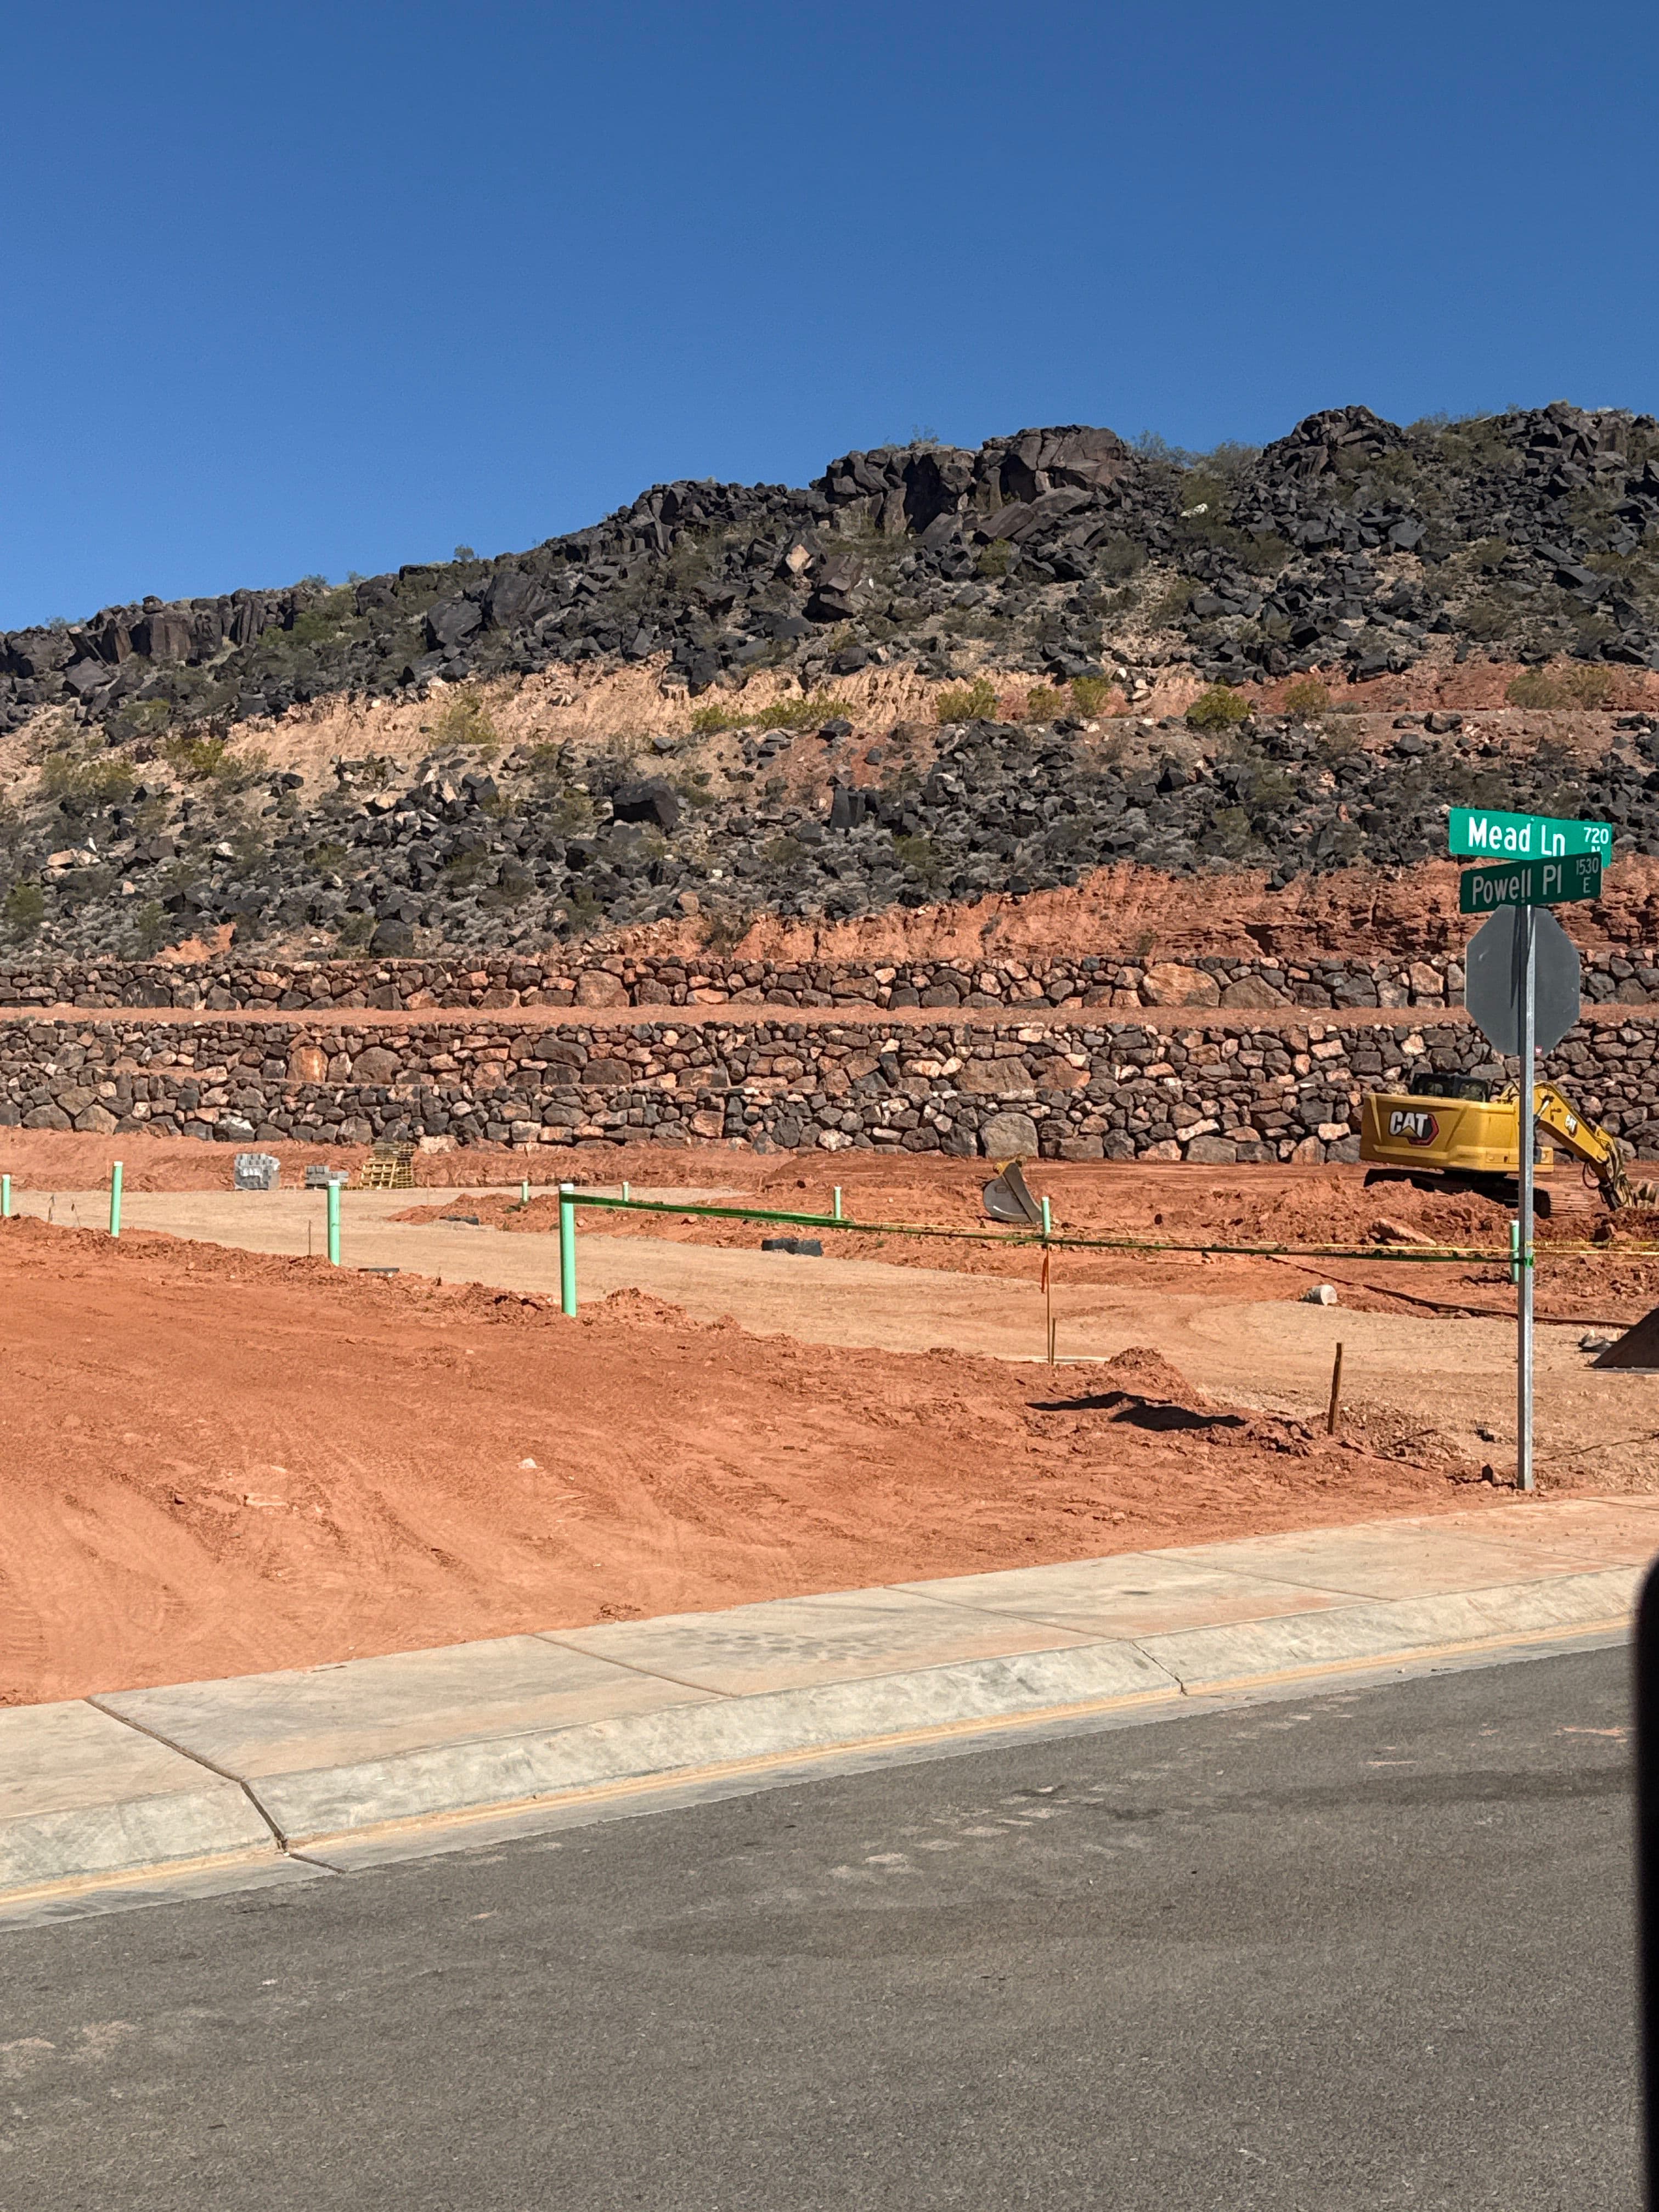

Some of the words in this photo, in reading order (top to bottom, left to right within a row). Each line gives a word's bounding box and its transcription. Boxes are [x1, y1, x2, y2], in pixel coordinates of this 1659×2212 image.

[1468, 816, 1531, 852] Mead
[1541, 824, 1565, 856] Ln
[1583, 827, 1609, 844] 720
[1576, 857, 1599, 876] 1530
[1472, 868, 1532, 905] Powell
[1543, 864, 1562, 895] Pl
[1583, 877, 1591, 894] E
[1390, 1111, 1429, 1138] CAT
